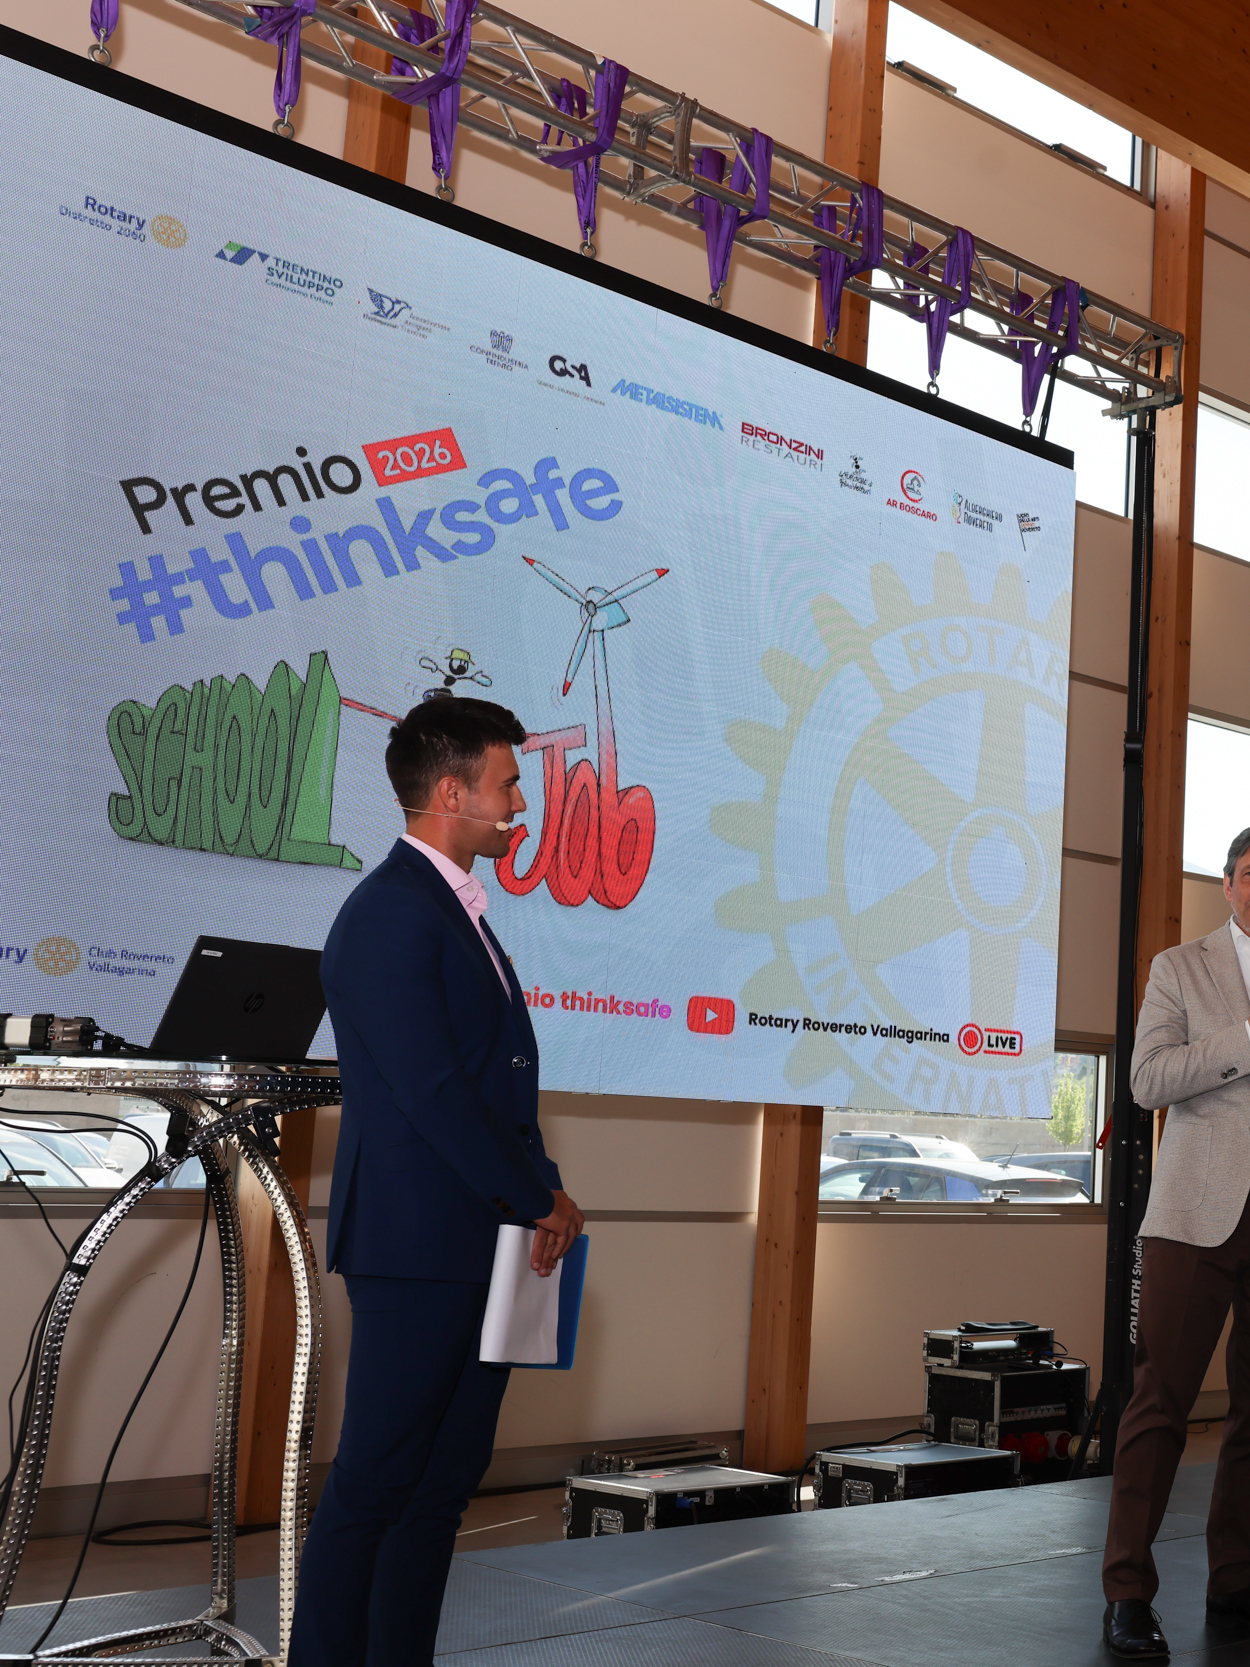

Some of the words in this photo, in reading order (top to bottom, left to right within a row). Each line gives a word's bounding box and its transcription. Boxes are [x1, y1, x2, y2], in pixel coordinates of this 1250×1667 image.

[59, 205, 112, 231] Distretto
[84, 195, 146, 231] Rotary
[266, 266, 335, 297] SVILUPPO
[273, 256, 343, 289] TRENTINO
[741, 421, 824, 461] BRONZINI
[741, 435, 823, 472] RESTAURI
[119, 445, 362, 536] Premio
[376, 438, 453, 477] 2026
[886, 498, 898, 509] AR
[899, 502, 938, 522] BOSCARO
[108, 456, 623, 644] #thinksafe
[107, 650, 362, 871] SCHOOL
[87, 946, 117, 960] Club
[120, 949, 175, 965] Rovereto
[87, 961, 156, 977] Vallagarina
[560, 990, 672, 1019] thinksafe
[748, 1012, 799, 1034] Rotary
[802, 1017, 867, 1037] Rovereto
[870, 1023, 951, 1045] Vallagarina
[987, 1034, 1017, 1051] LIVE
